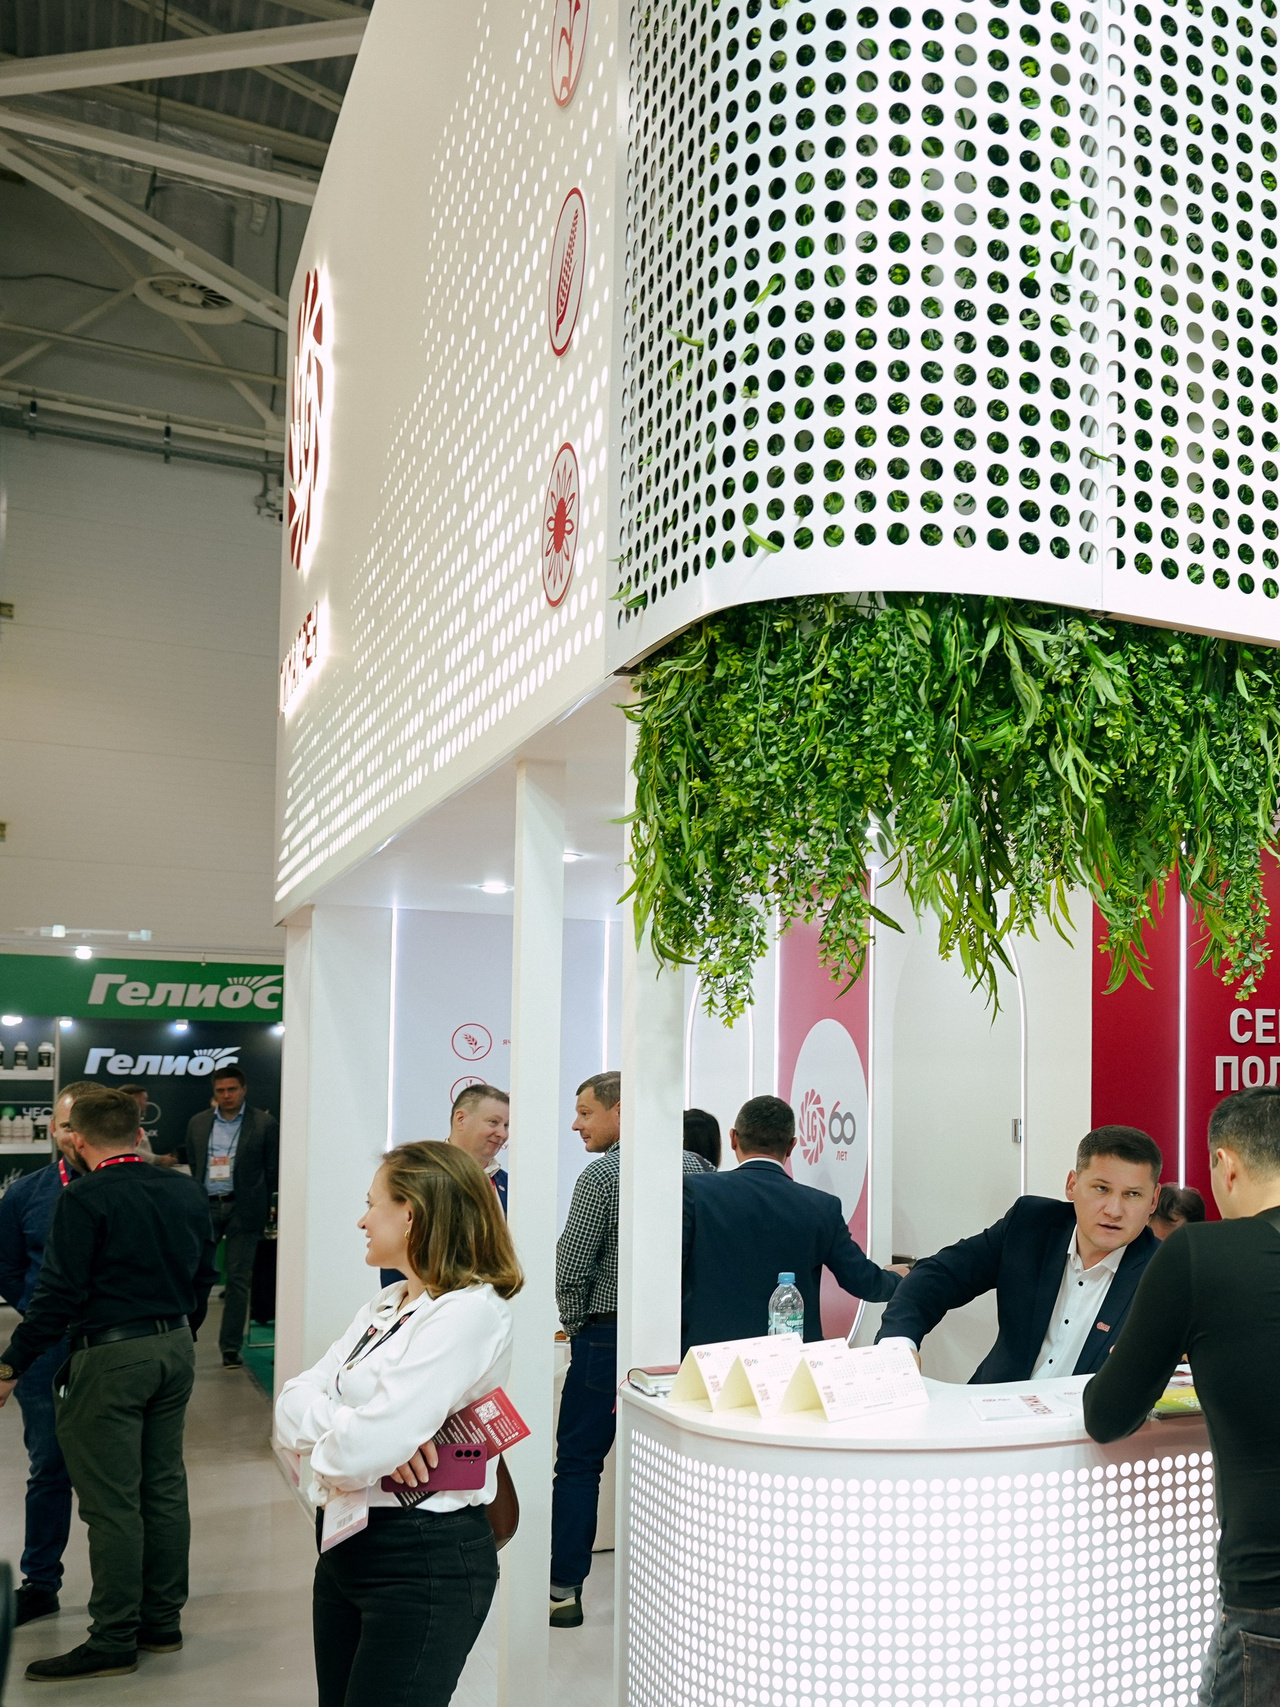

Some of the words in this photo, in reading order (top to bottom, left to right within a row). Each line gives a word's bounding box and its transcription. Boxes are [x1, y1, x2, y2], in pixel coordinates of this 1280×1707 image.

[88, 973, 283, 1010] Гелиос
[806, 1110, 817, 1143] LG
[828, 1100, 856, 1146] 60
[835, 1150, 848, 1161] лет
